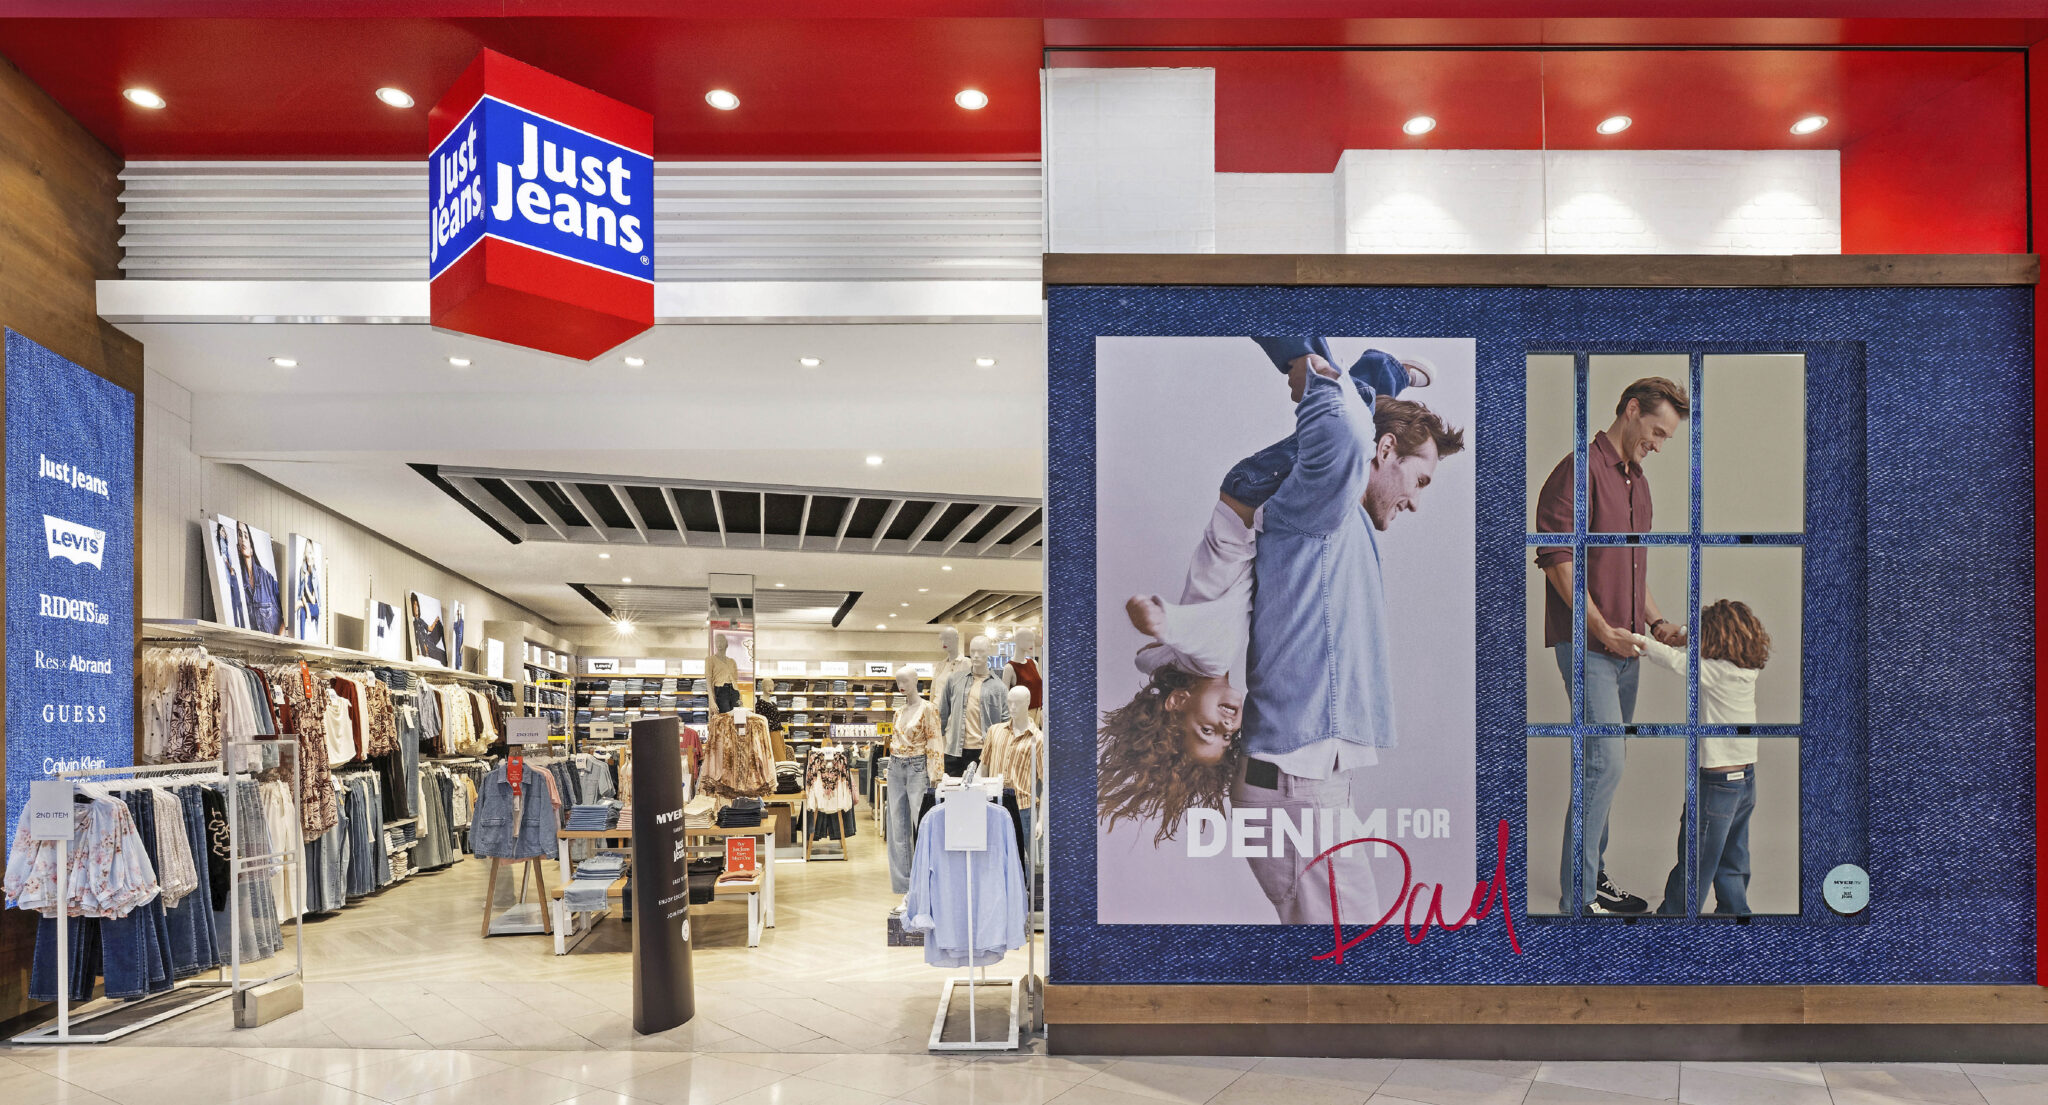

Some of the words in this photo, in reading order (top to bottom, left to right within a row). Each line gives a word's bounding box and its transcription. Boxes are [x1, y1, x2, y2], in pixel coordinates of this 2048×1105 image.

[438, 121, 477, 210] Just
[517, 121, 631, 206] Just
[431, 174, 482, 264] Jeans
[491, 161, 644, 254] Jeans
[39, 453, 70, 483] Just
[71, 465, 108, 497] Jeans
[35, 649, 59, 670] Res
[69, 654, 112, 675] Abrand
[42, 704, 106, 723] GUESS
[43, 757, 80, 775] Calvin
[80, 756, 106, 770] Klein
[656, 808, 683, 825] MYER
[1186, 807, 1387, 858] DENIM
[1397, 808, 1450, 839] FOR
[1300, 819, 1522, 965] Dad
